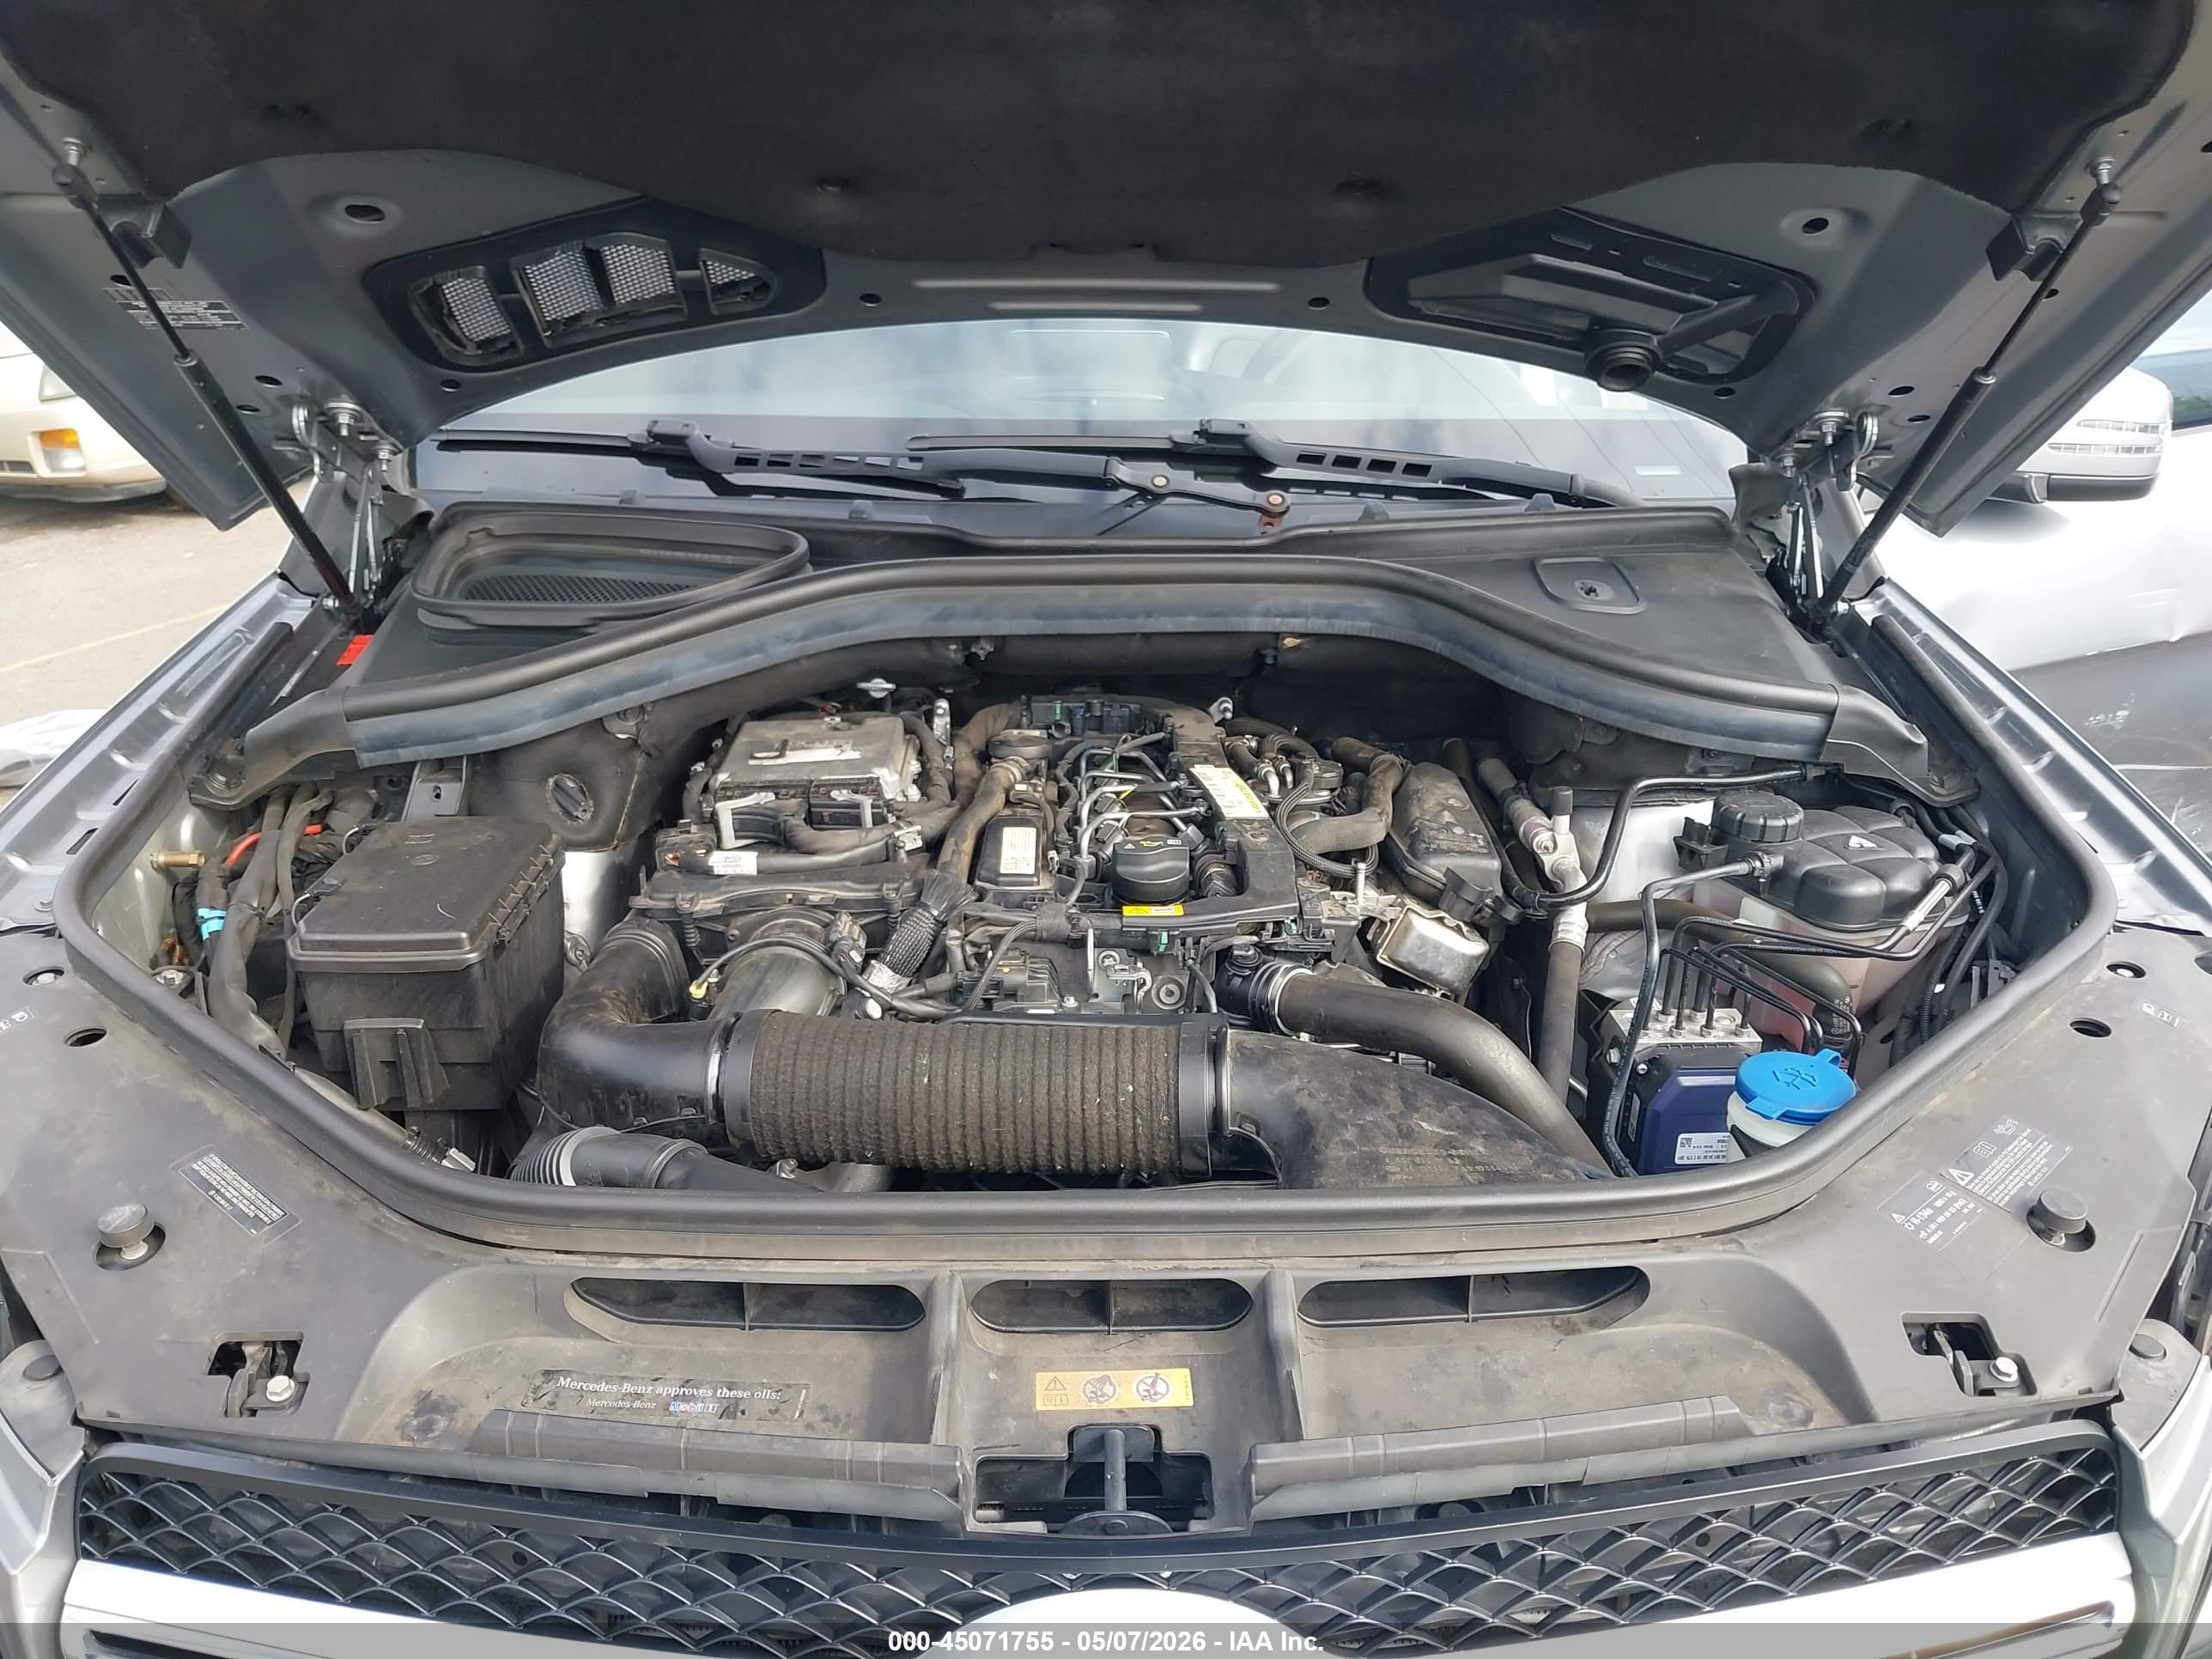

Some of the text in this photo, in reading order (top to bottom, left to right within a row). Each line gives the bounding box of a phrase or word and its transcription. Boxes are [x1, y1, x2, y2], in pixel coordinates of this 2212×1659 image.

[556, 1376, 781, 1400] Mercedes-Benz approves these oils:
[586, 1399, 656, 1408] Mercedes-Benz
